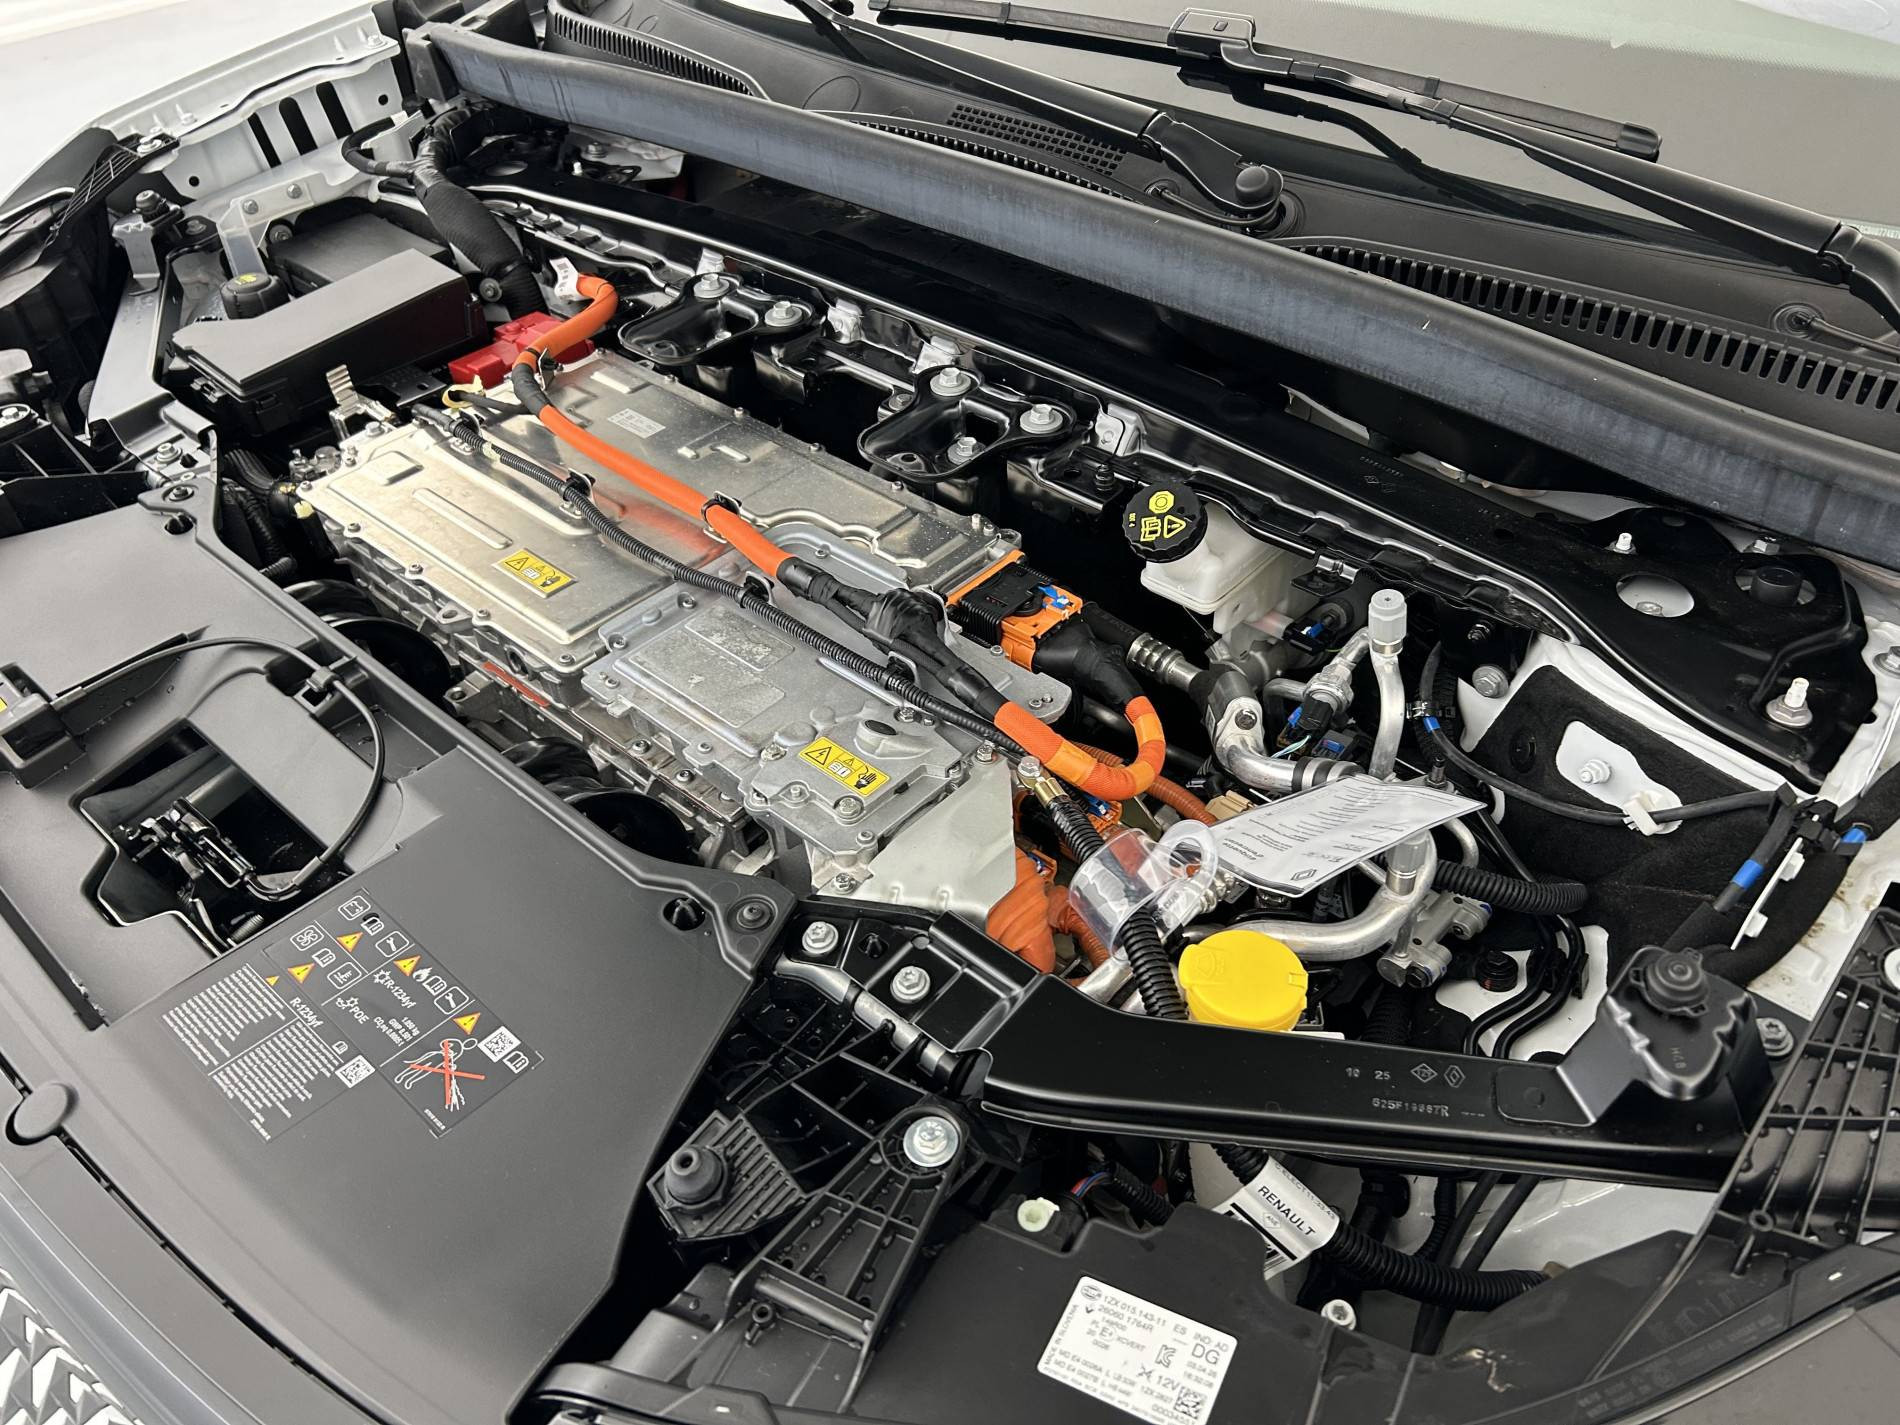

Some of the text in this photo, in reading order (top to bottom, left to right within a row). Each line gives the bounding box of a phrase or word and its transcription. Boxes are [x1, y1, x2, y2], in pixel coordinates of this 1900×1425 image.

[384, 978, 416, 1009] R-1234yf
[290, 997, 324, 1028] R-1234yf
[349, 1006, 369, 1024] POE
[1374, 1070, 1391, 1080] 25
[1257, 1185, 1316, 1236] RENAULT
[1191, 1343, 1220, 1365] DG
[1156, 1374, 1179, 1392] 12V
